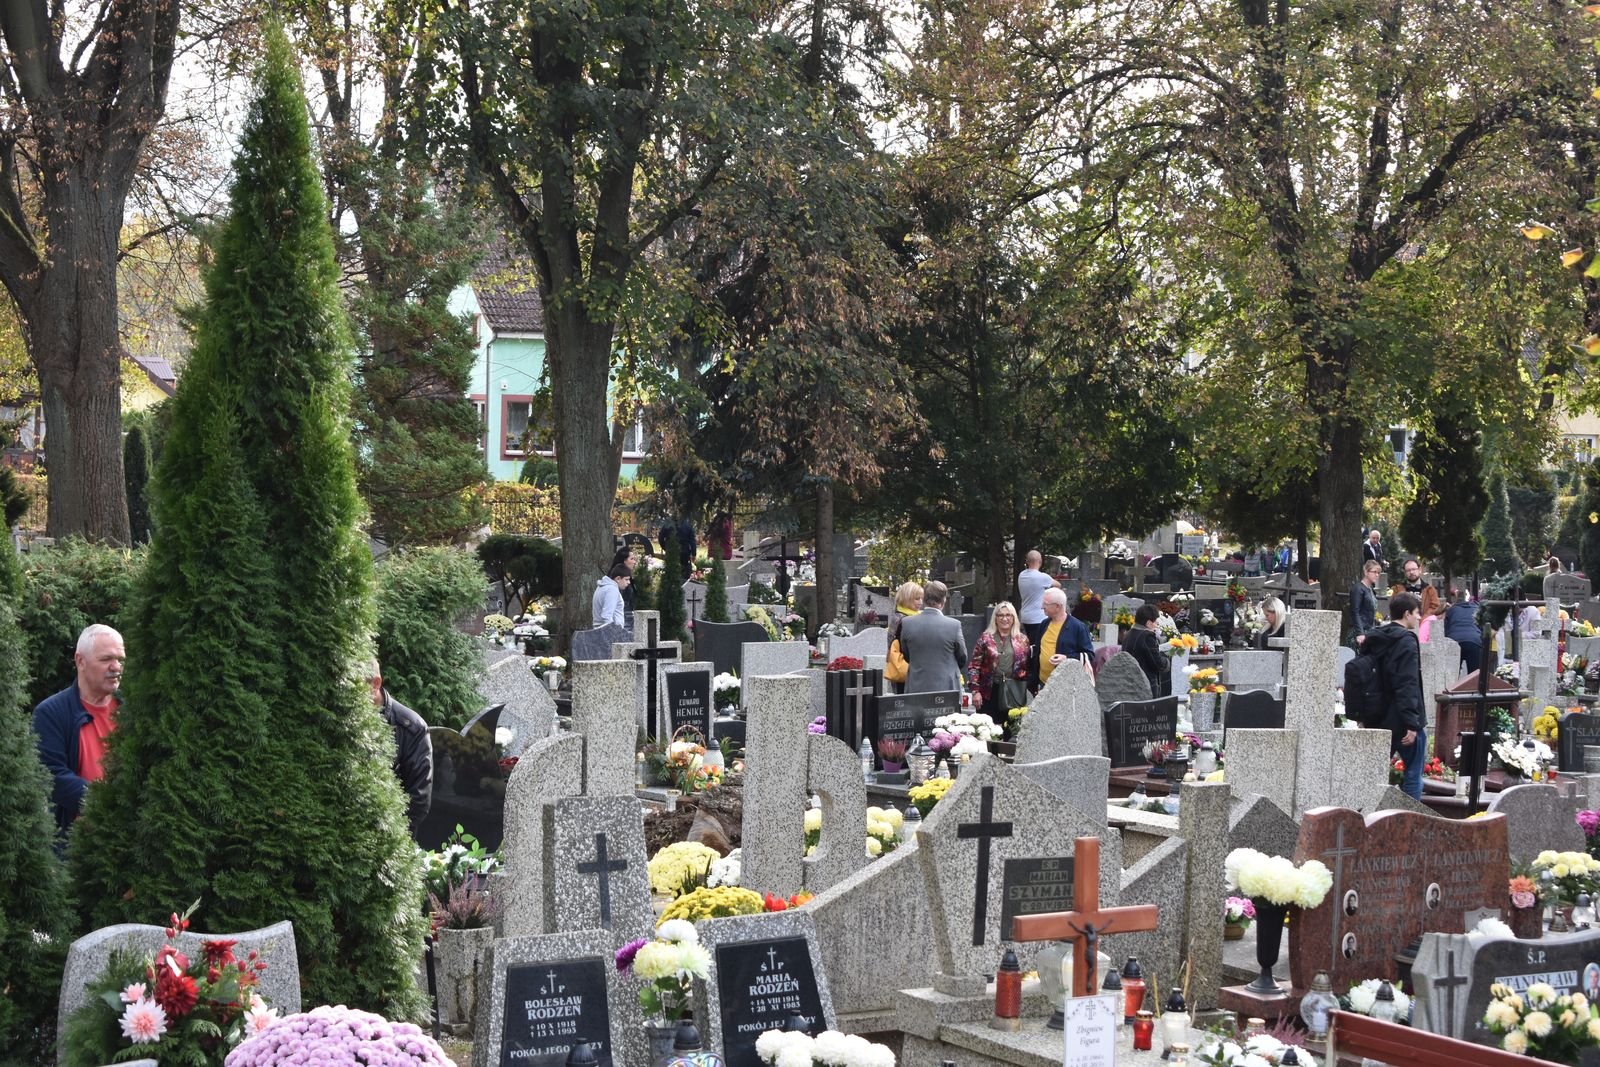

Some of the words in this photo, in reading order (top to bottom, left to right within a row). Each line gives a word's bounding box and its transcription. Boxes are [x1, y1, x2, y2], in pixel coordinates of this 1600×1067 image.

[676, 707, 704, 717] HENIKE
[884, 720, 914, 730] DOGIEL
[1129, 723, 1171, 733] SZCZEPANIAK
[1030, 871, 1067, 882] MARIAN
[1010, 885, 1073, 898] SZYMAN
[1527, 948, 1546, 964] Ś.P.
[777, 962, 784, 970] P
[756, 973, 791, 984] MARIA
[558, 985, 566, 993] P
[749, 978, 800, 996] RODZEŃ
[524, 995, 583, 1009] BOLESŁAW
[782, 995, 800, 1003] 1914
[557, 1020, 576, 1028] 1918
[738, 1021, 766, 1032] POKÓJ
[769, 1020, 785, 1029] JEJ
[510, 1047, 541, 1059] POKÓJ
[543, 1045, 570, 1055] JEGO
